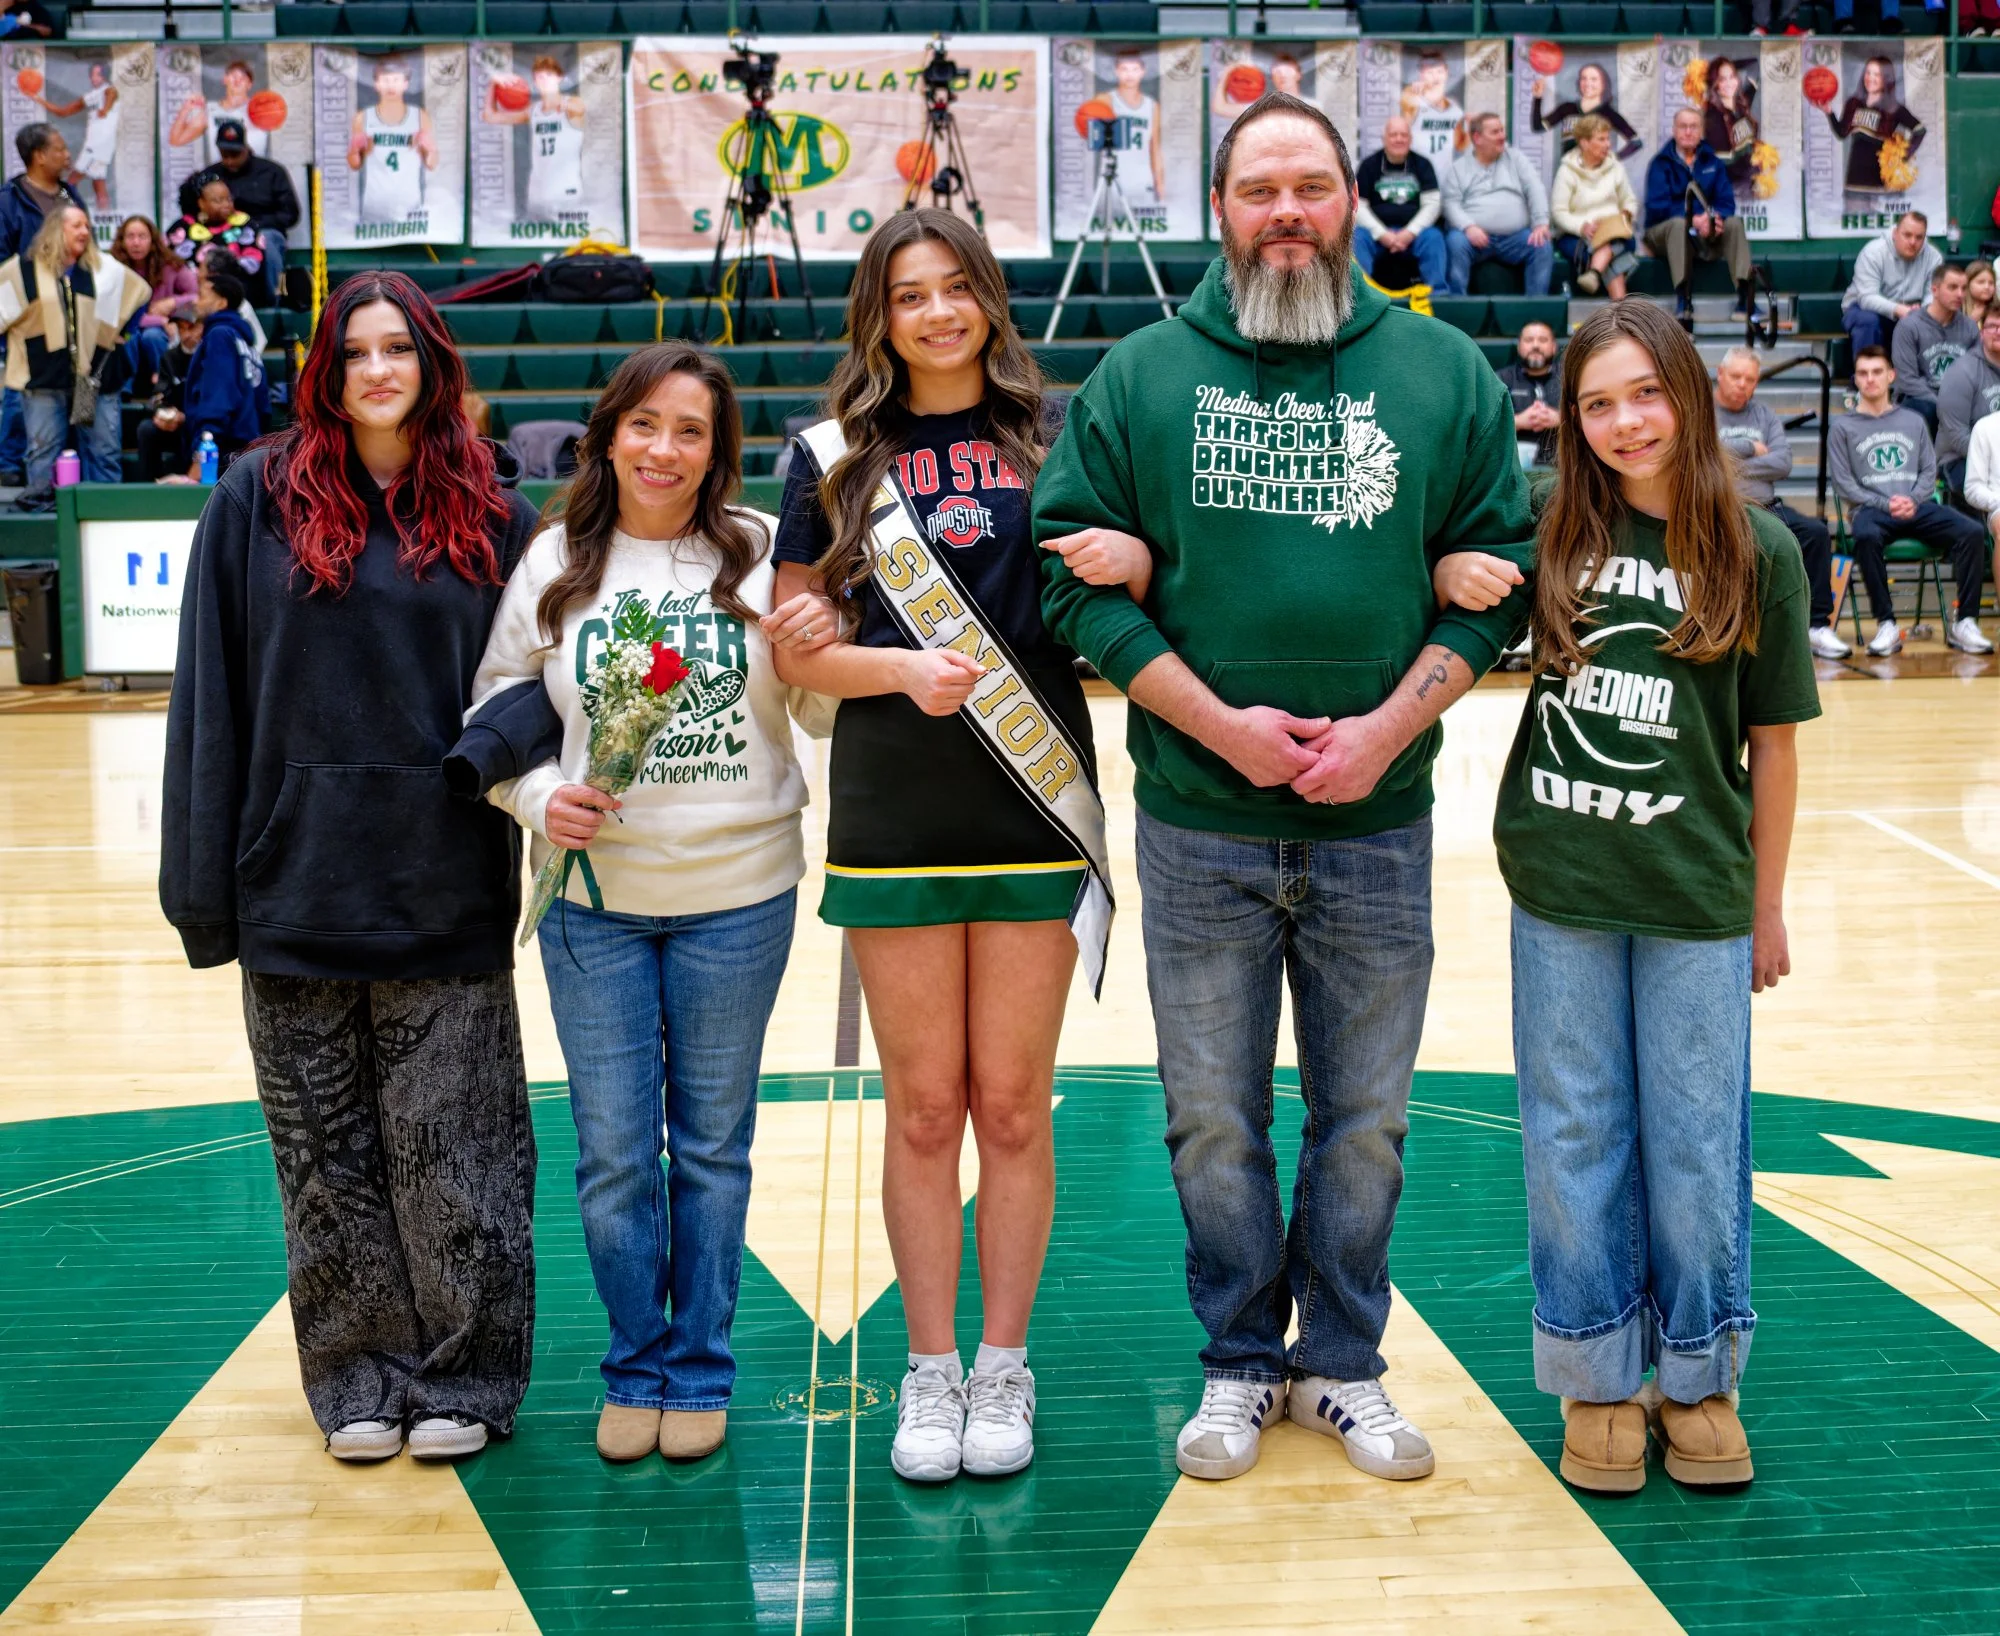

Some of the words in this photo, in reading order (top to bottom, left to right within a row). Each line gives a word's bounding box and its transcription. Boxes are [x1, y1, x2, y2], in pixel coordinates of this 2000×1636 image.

[649, 69, 1022, 94] CONATULATONS
[323, 132, 349, 207] MEDINA
[386, 151, 399, 171] 4
[479, 130, 505, 207] MEDINA
[511, 222, 590, 239] KOPKAS
[1841, 213, 1899, 229] REE
[1195, 384, 1272, 418] Medina
[1274, 392, 1326, 420] Cheer
[1328, 391, 1376, 418] Dad
[1194, 412, 1297, 451] THAT'S
[896, 447, 940, 497] IO
[949, 440, 1025, 492] STA
[1193, 442, 1348, 483] DAUGHTER
[1193, 474, 1246, 509] OUT
[1248, 479, 1348, 515] THERE!
[657, 587, 707, 618] last
[1577, 554, 1692, 613] AM
[102, 604, 181, 618] Nationwi
[576, 613, 748, 686] CEER
[877, 536, 1077, 804] SENIOR
[1563, 661, 1675, 725] MEDINA
[1618, 718, 1679, 740] BASKETBALL
[1532, 766, 1685, 826] DAY
